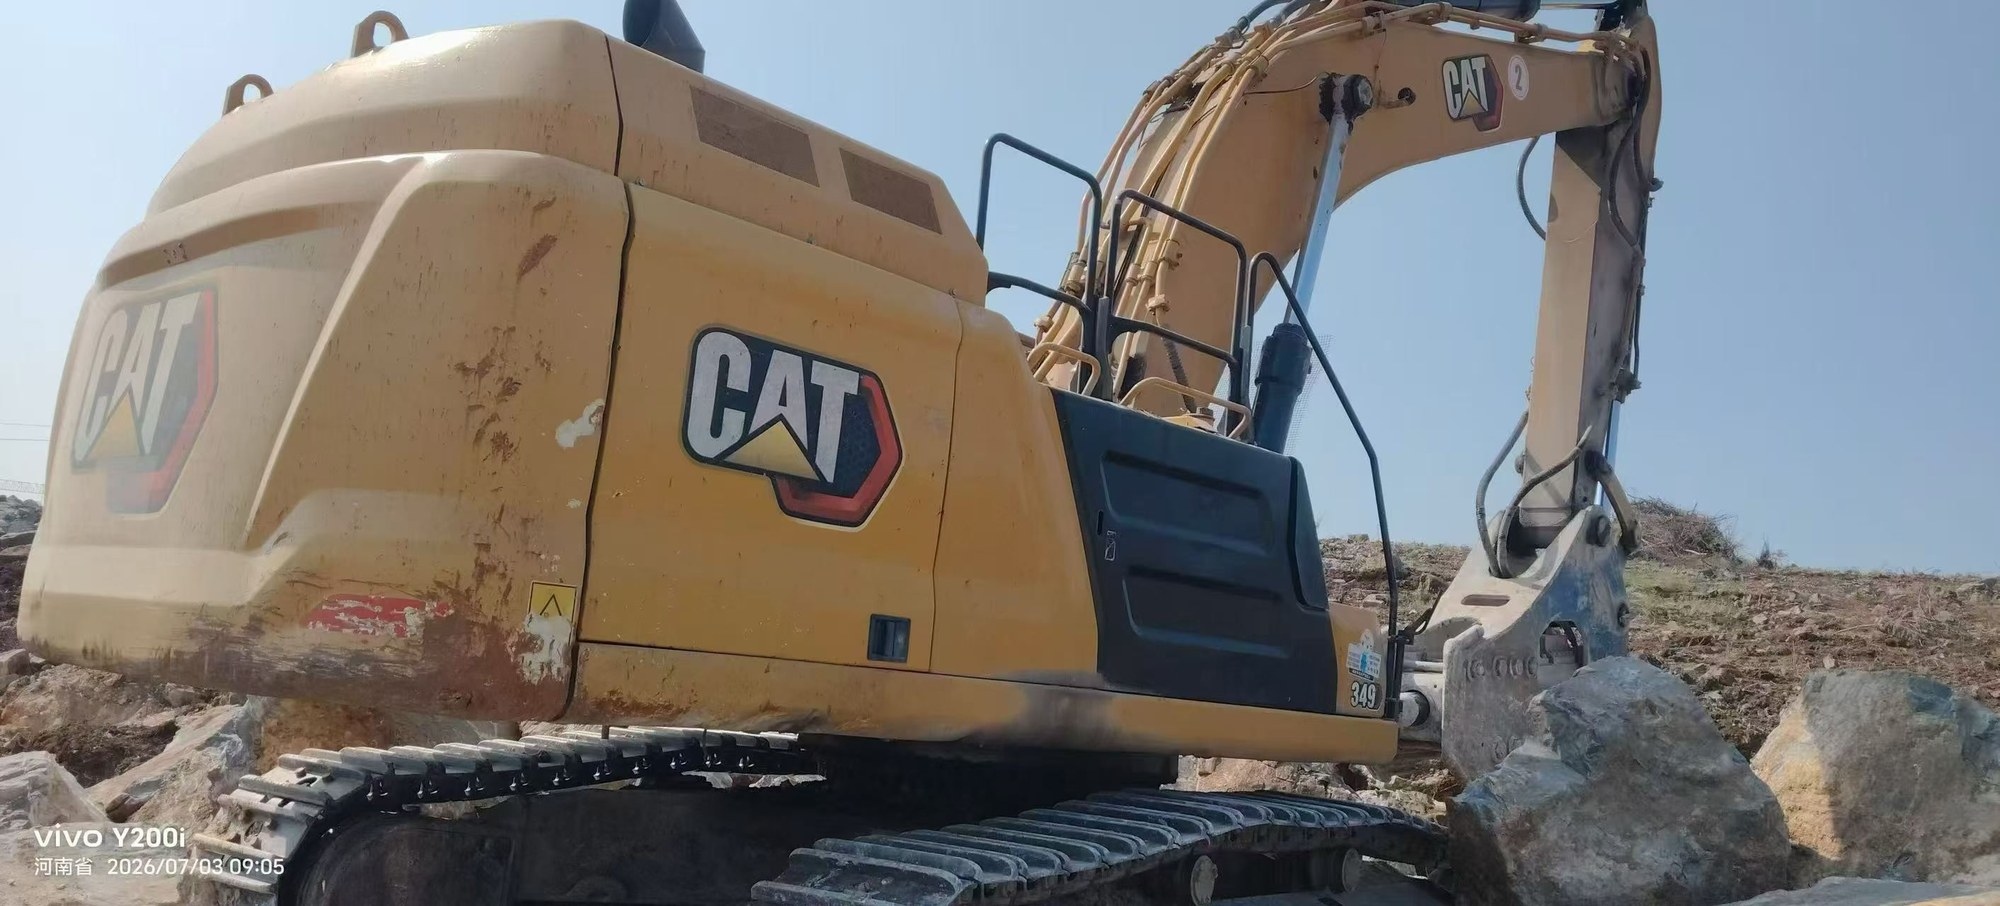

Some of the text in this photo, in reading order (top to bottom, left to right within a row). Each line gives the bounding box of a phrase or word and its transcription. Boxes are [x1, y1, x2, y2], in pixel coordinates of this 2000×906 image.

[1443, 57, 1489, 119] CAT
[1514, 63, 1523, 92] 2
[73, 291, 201, 464] CAT
[687, 331, 860, 484] CAT
[1351, 681, 1377, 709] 349
